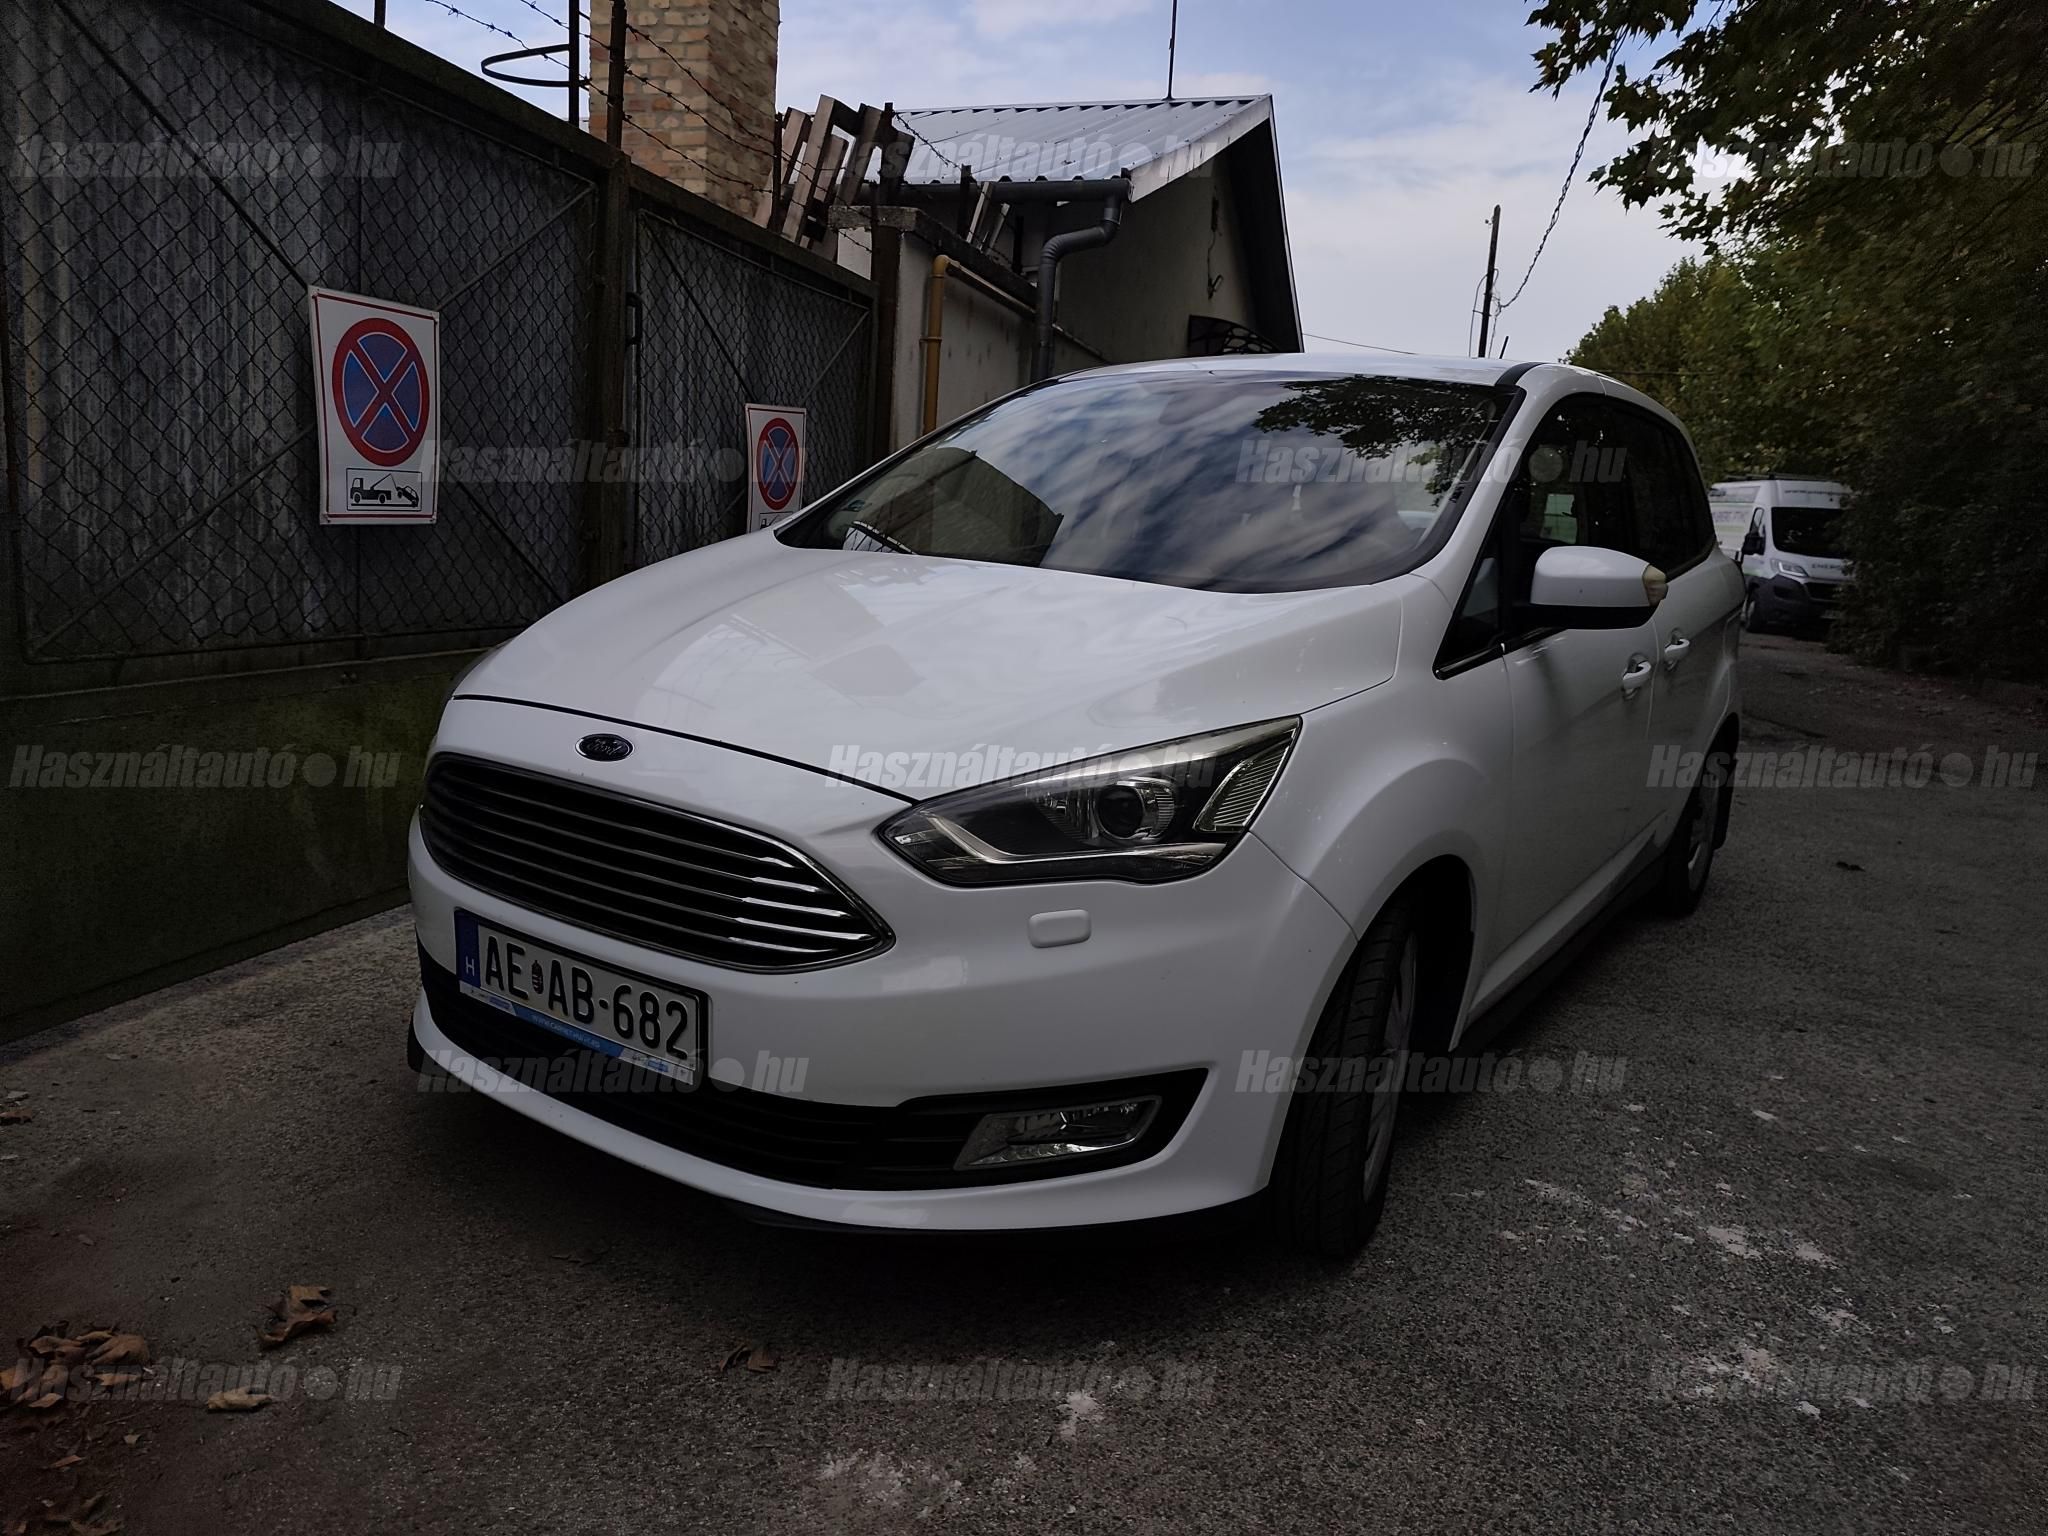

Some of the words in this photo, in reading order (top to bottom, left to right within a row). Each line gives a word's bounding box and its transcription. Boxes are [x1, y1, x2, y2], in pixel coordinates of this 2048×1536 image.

[586, 737, 622, 756] Ford
[465, 955, 476, 977] H
[547, 958, 689, 1061] AB-682
